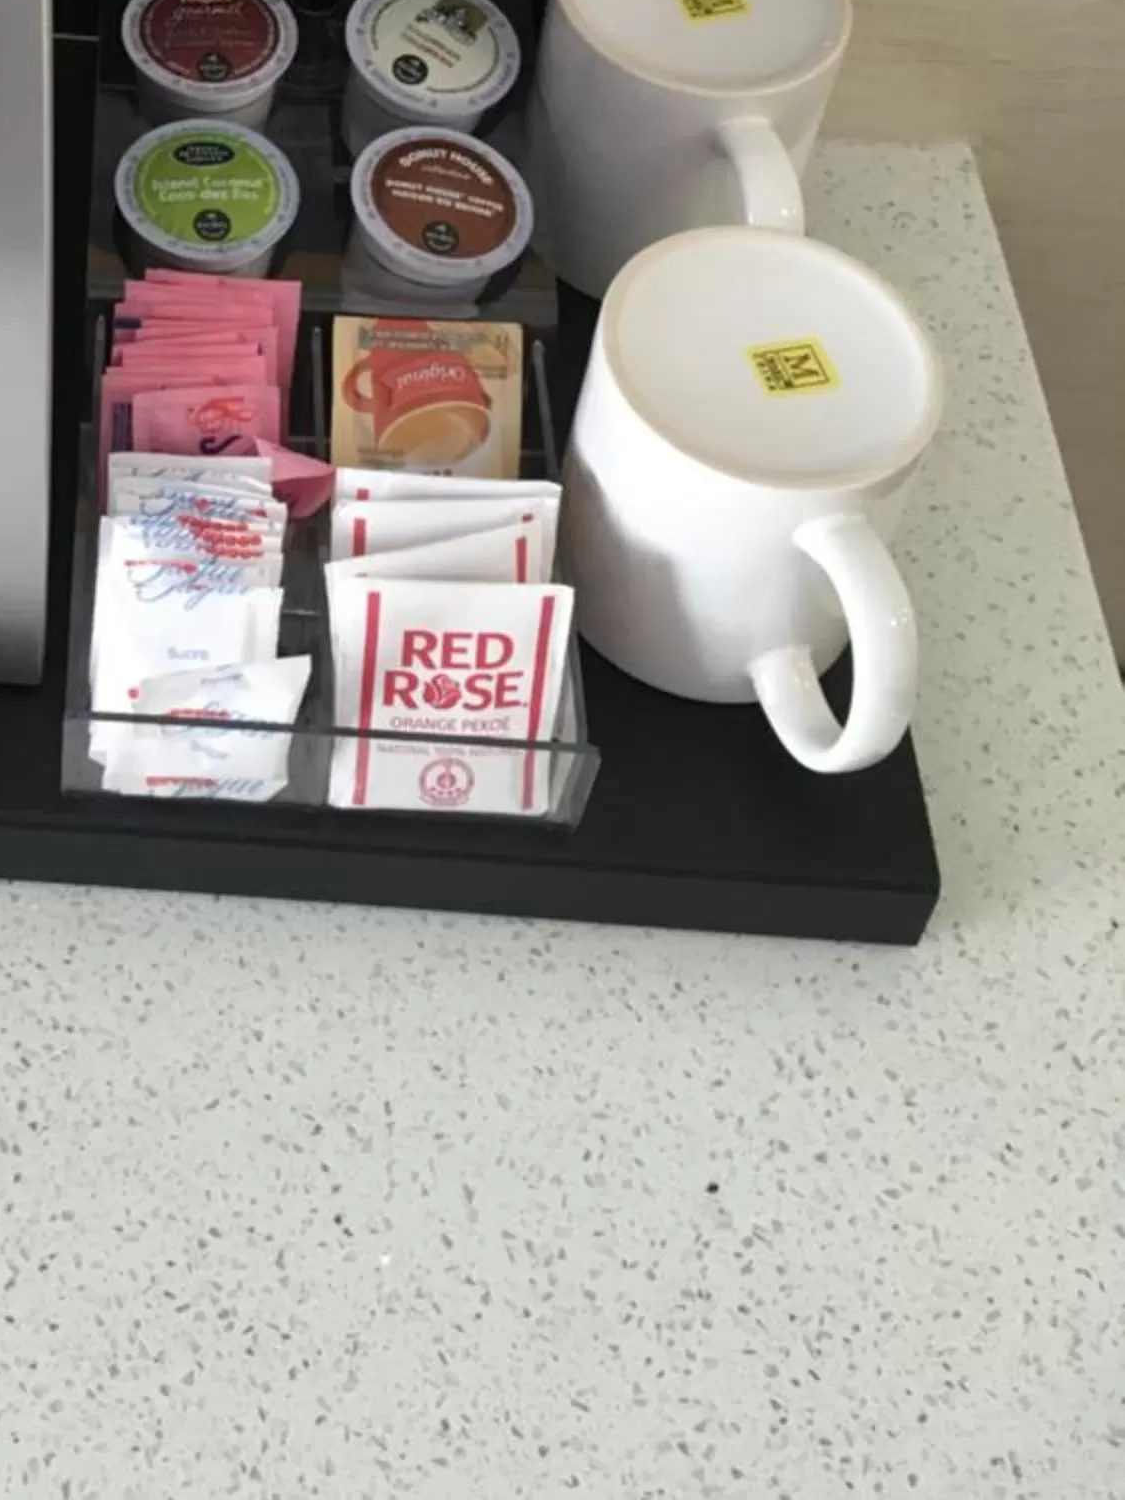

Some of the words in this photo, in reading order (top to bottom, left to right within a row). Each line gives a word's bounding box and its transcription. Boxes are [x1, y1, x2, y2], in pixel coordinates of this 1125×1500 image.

[400, 629, 516, 670] RED
[382, 668, 525, 712] ROSE
[388, 715, 458, 732] ORANGE
